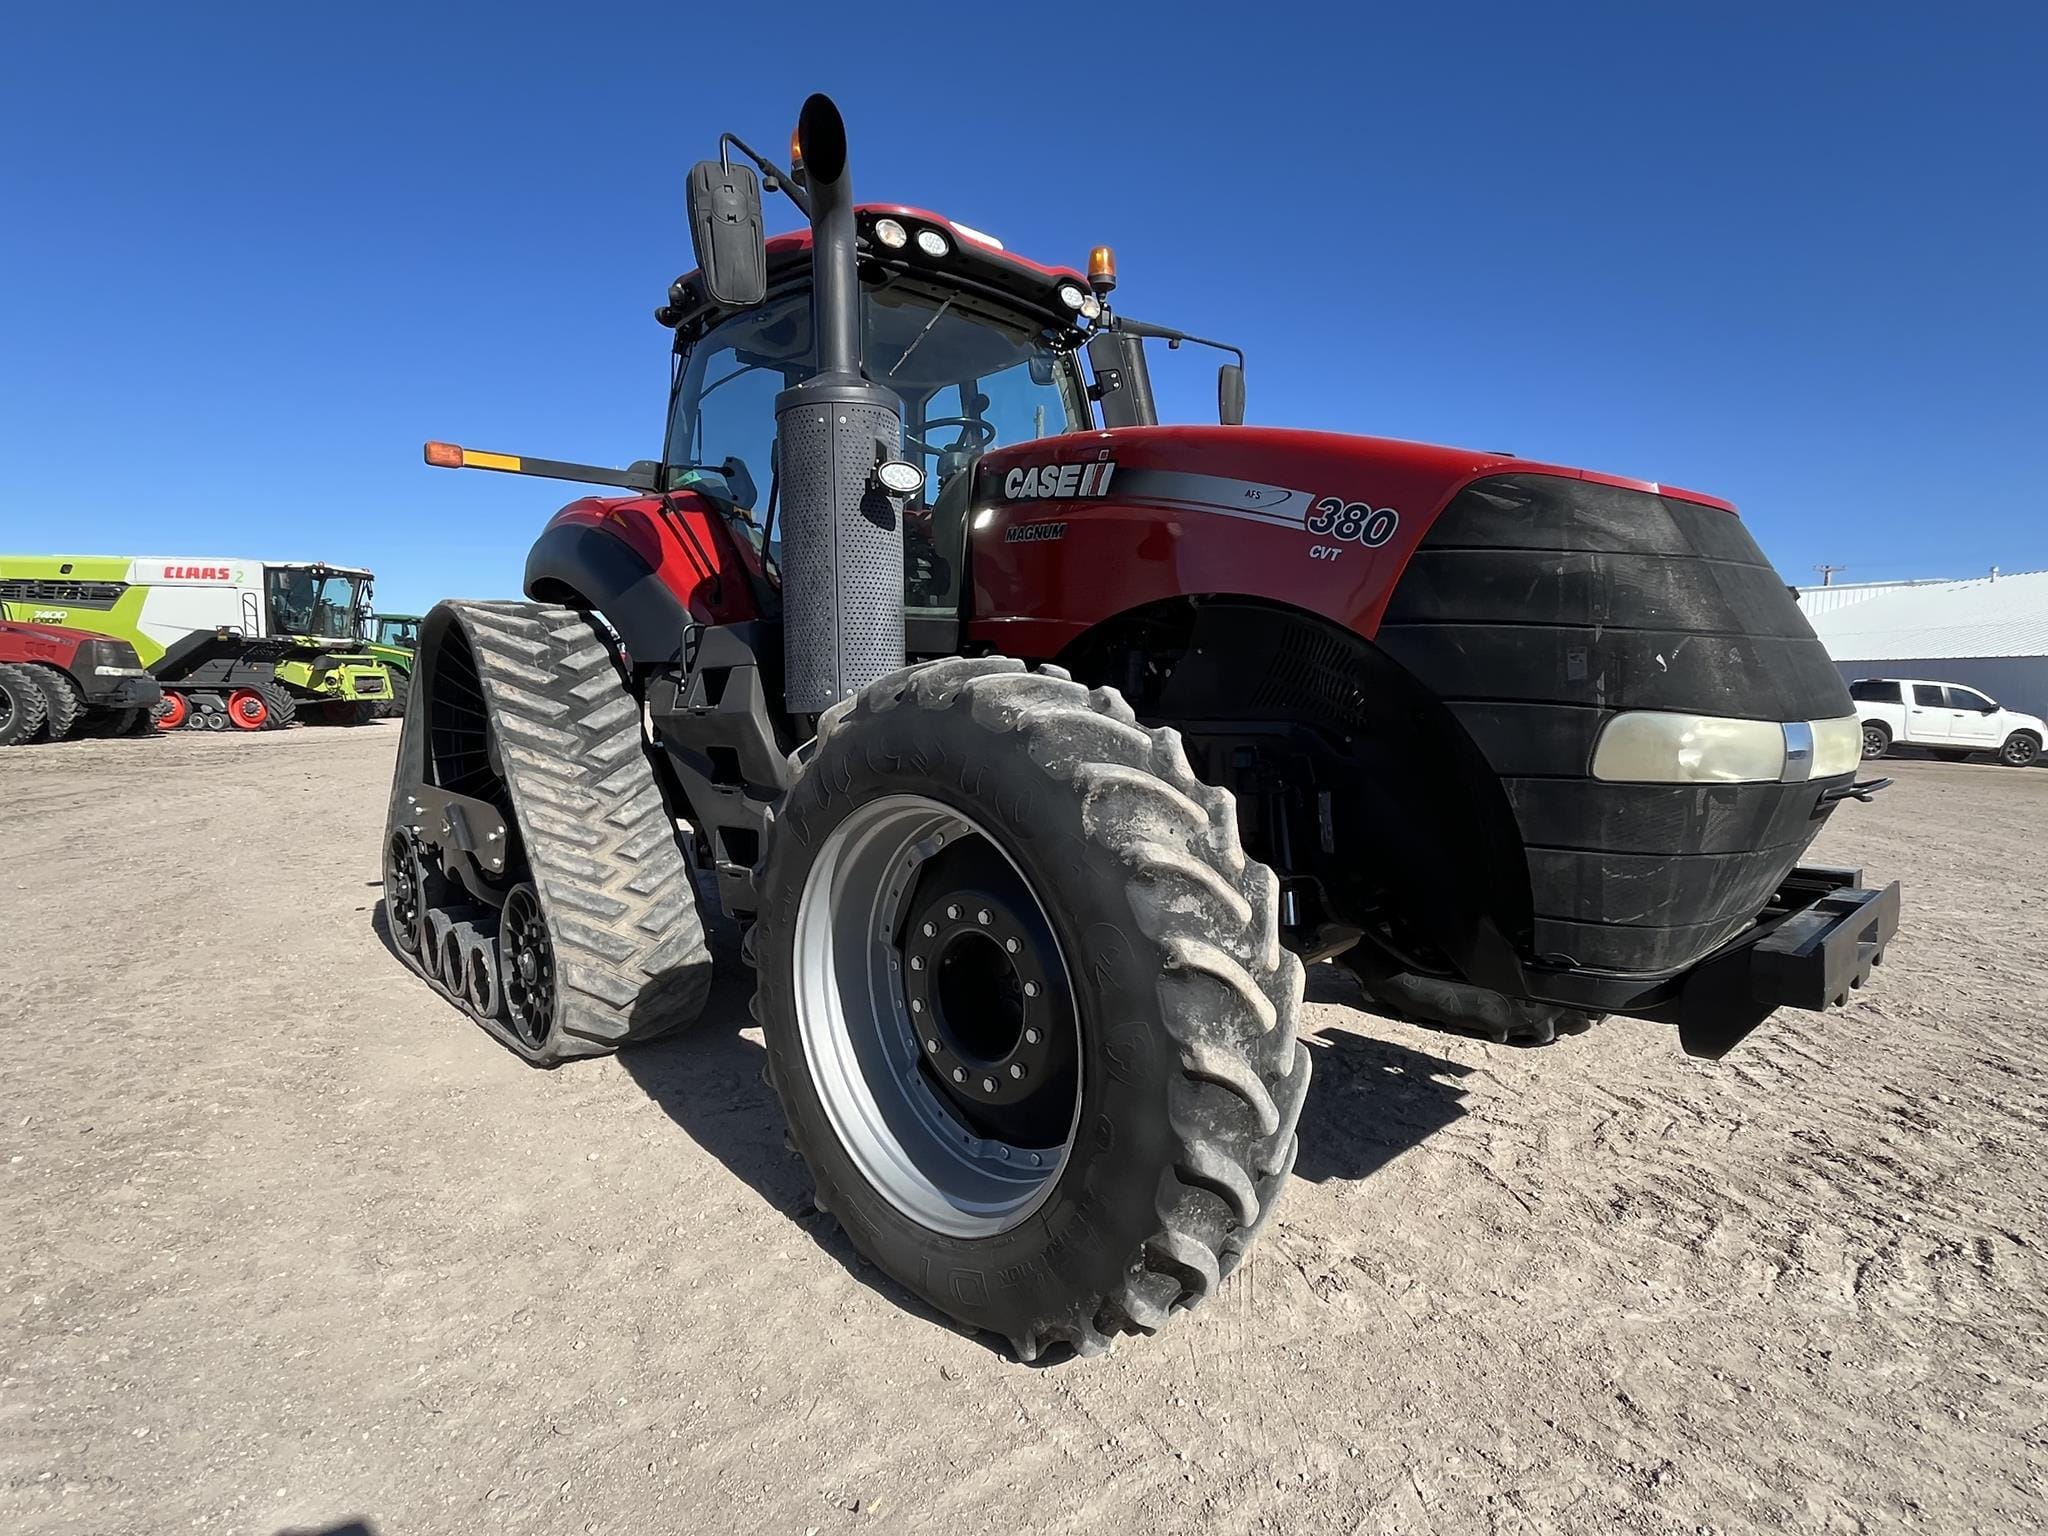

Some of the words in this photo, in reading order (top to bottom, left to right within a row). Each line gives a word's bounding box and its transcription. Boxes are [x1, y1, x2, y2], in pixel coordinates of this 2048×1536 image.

[1245, 489, 1261, 500] AFS
[1308, 497, 1399, 548] 380
[1005, 523, 1068, 543] MAGNUM
[1310, 545, 1342, 561] CVT
[164, 567, 230, 580] CLAAS
[34, 610, 68, 619] 7400
